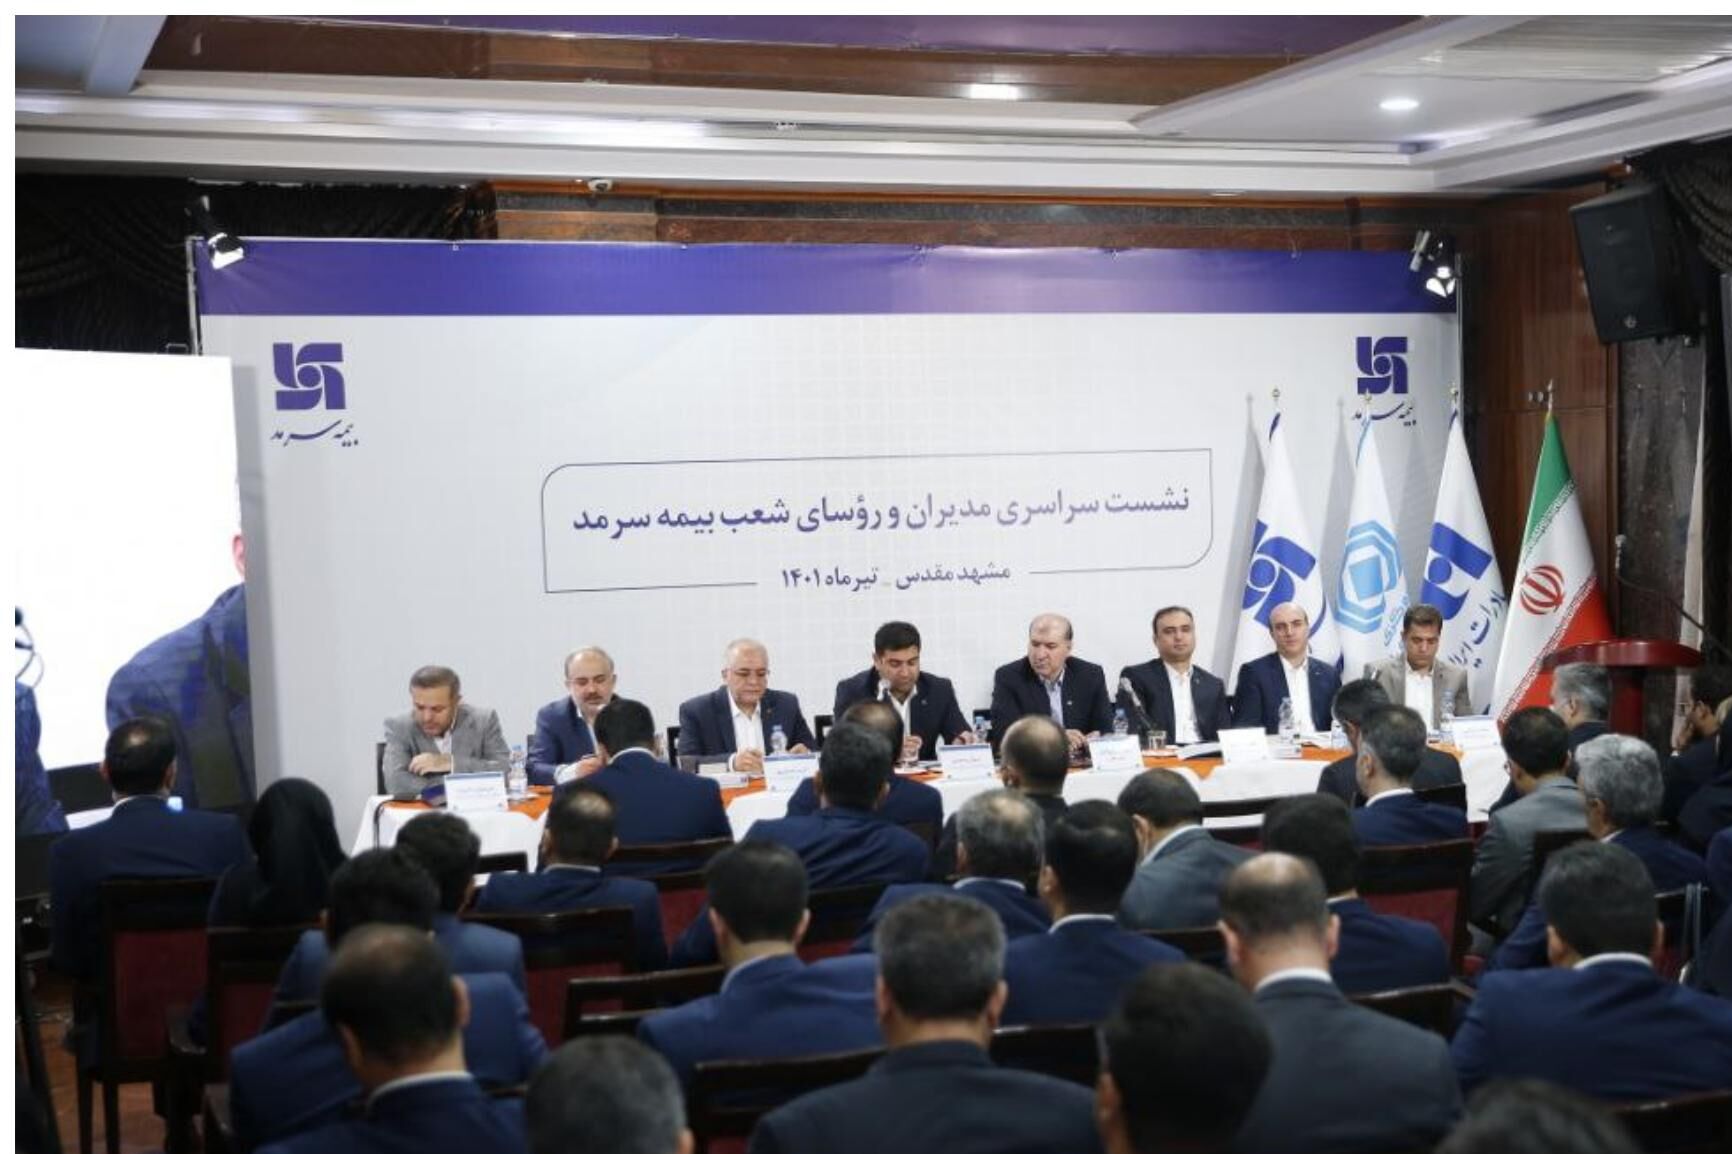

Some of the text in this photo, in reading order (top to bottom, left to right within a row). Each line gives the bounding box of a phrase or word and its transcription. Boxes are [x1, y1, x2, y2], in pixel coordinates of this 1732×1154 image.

[270, 419, 359, 448] بیمه سرمد
[572, 487, 1190, 539] نشست سراسری مدیران و رؤسای شعب بیمه سرمد
[895, 564, 954, 590] مقدس
[957, 561, 1011, 586] مشهد
